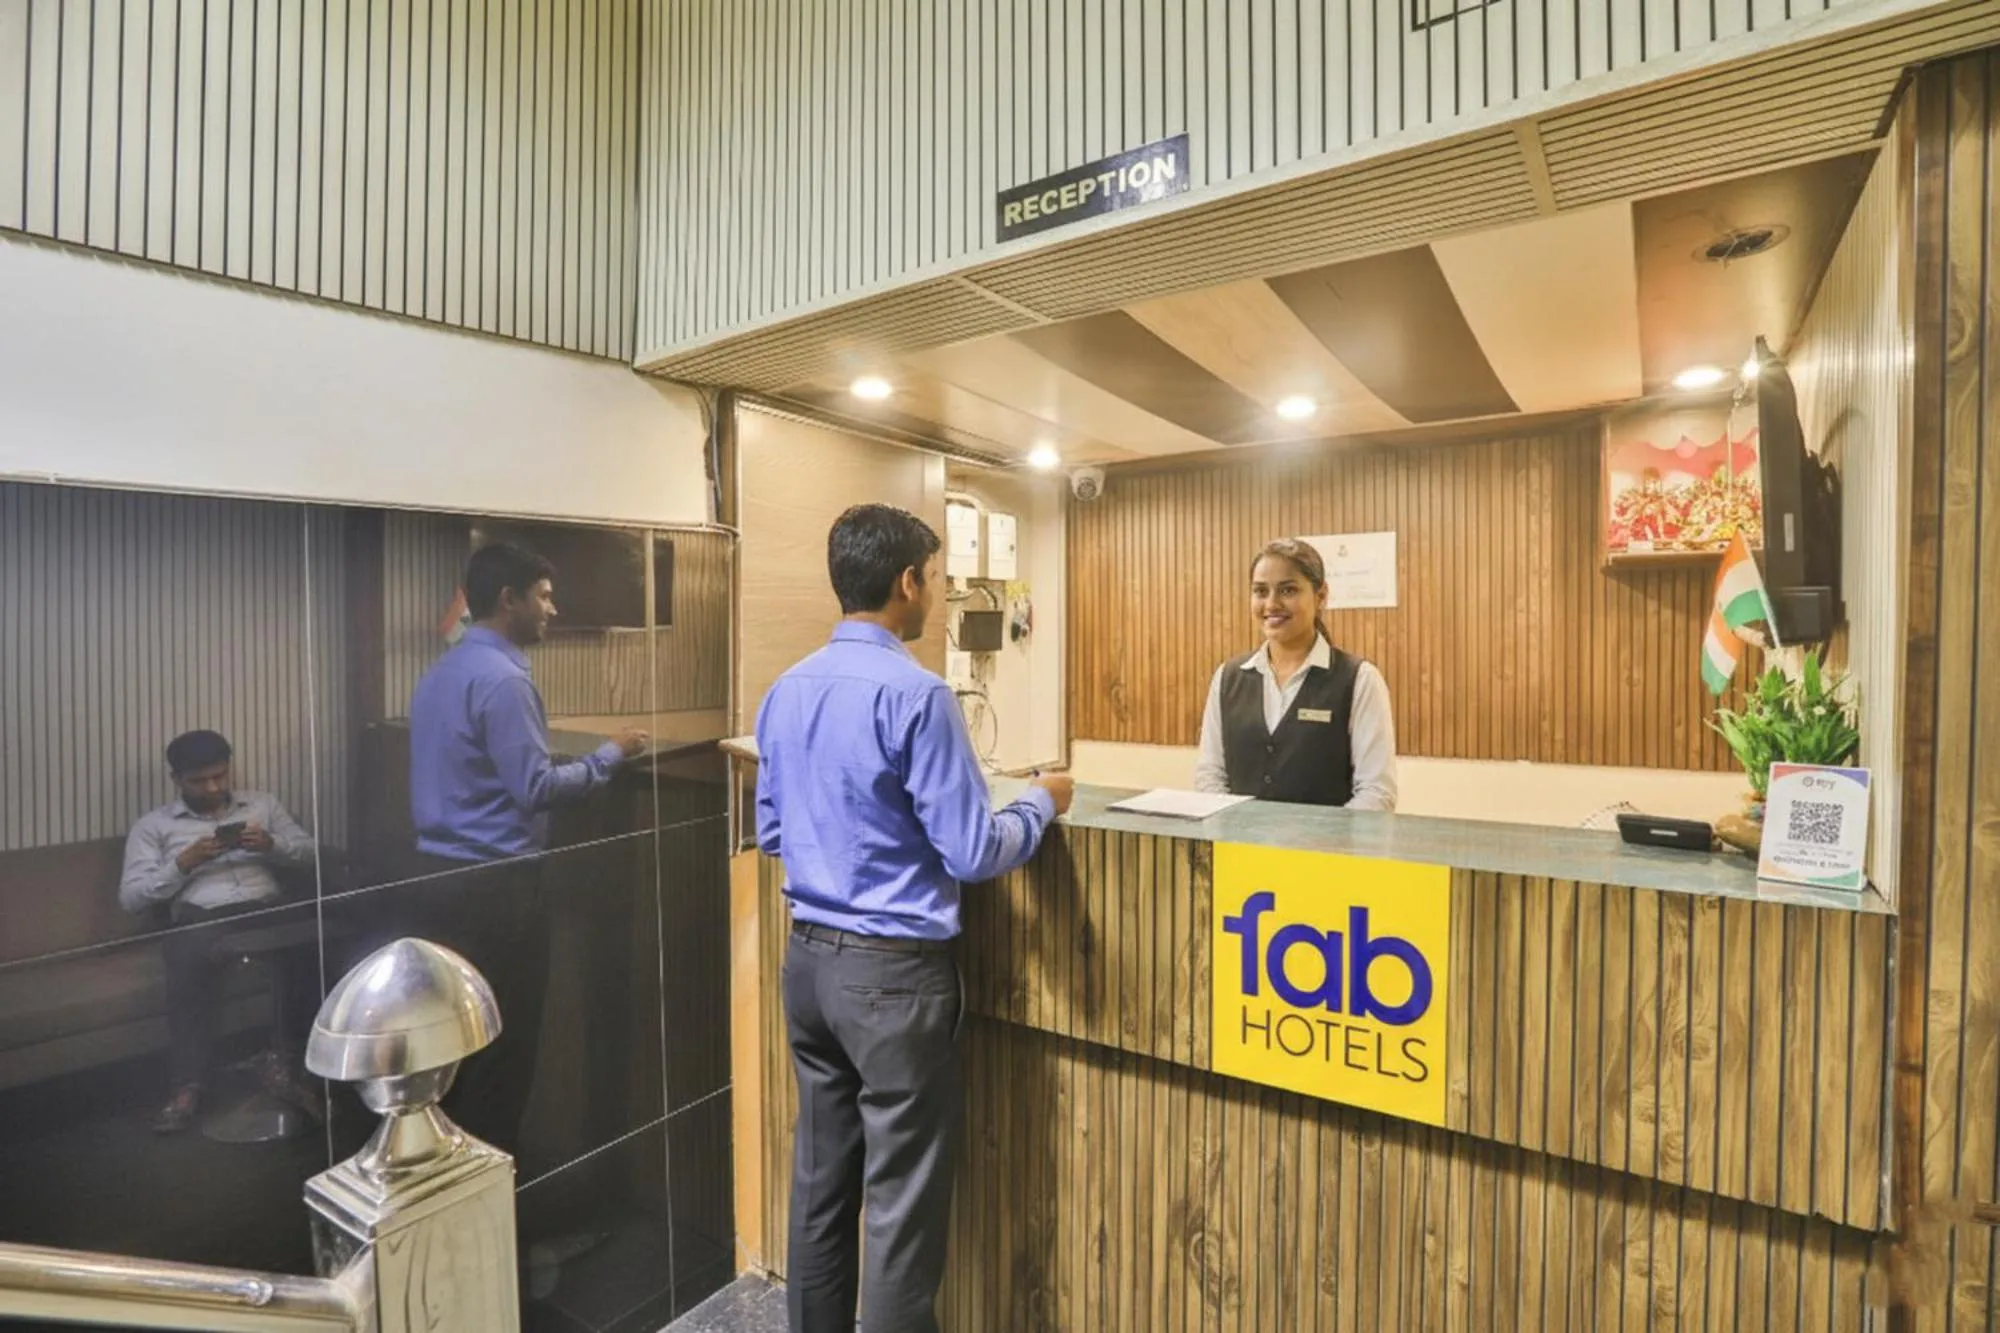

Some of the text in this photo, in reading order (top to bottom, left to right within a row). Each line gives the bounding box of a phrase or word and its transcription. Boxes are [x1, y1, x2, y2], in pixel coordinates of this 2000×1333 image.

[1004, 153, 1176, 227] RECEPTION
[1223, 891, 1433, 1026] fab
[1242, 1004, 1429, 1083] HOTELS
